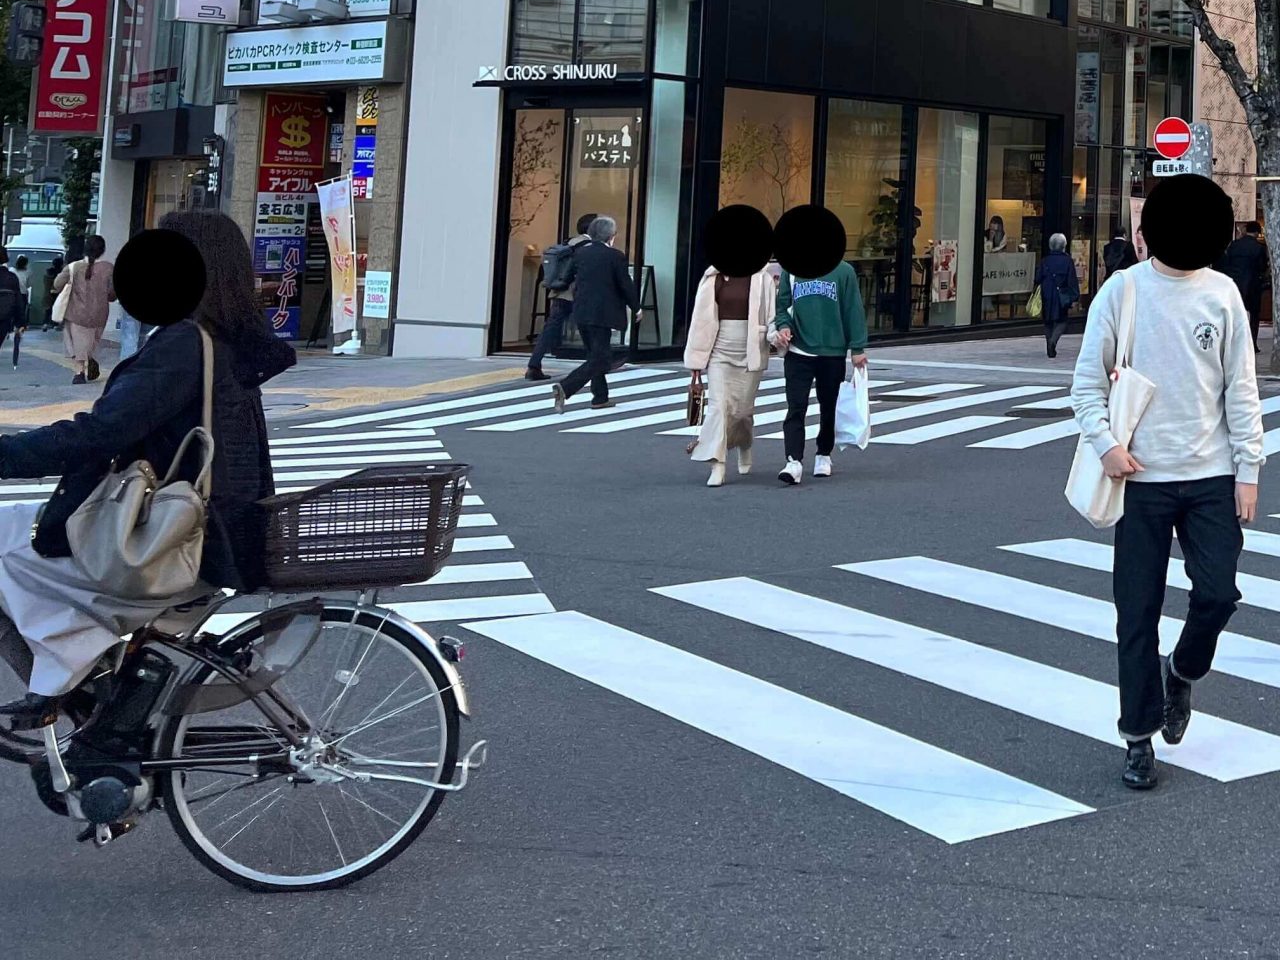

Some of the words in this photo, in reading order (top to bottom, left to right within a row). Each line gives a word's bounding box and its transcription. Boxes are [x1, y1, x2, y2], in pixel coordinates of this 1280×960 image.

[504, 65, 547, 81] CROSS
[552, 63, 618, 80] SHINJUKU
[586, 133, 620, 147] リトル
[583, 150, 631, 164] バステト
[269, 177, 313, 192] アイフル
[258, 203, 305, 216] 宝石広場
[271, 247, 300, 330] ハンバーグ
